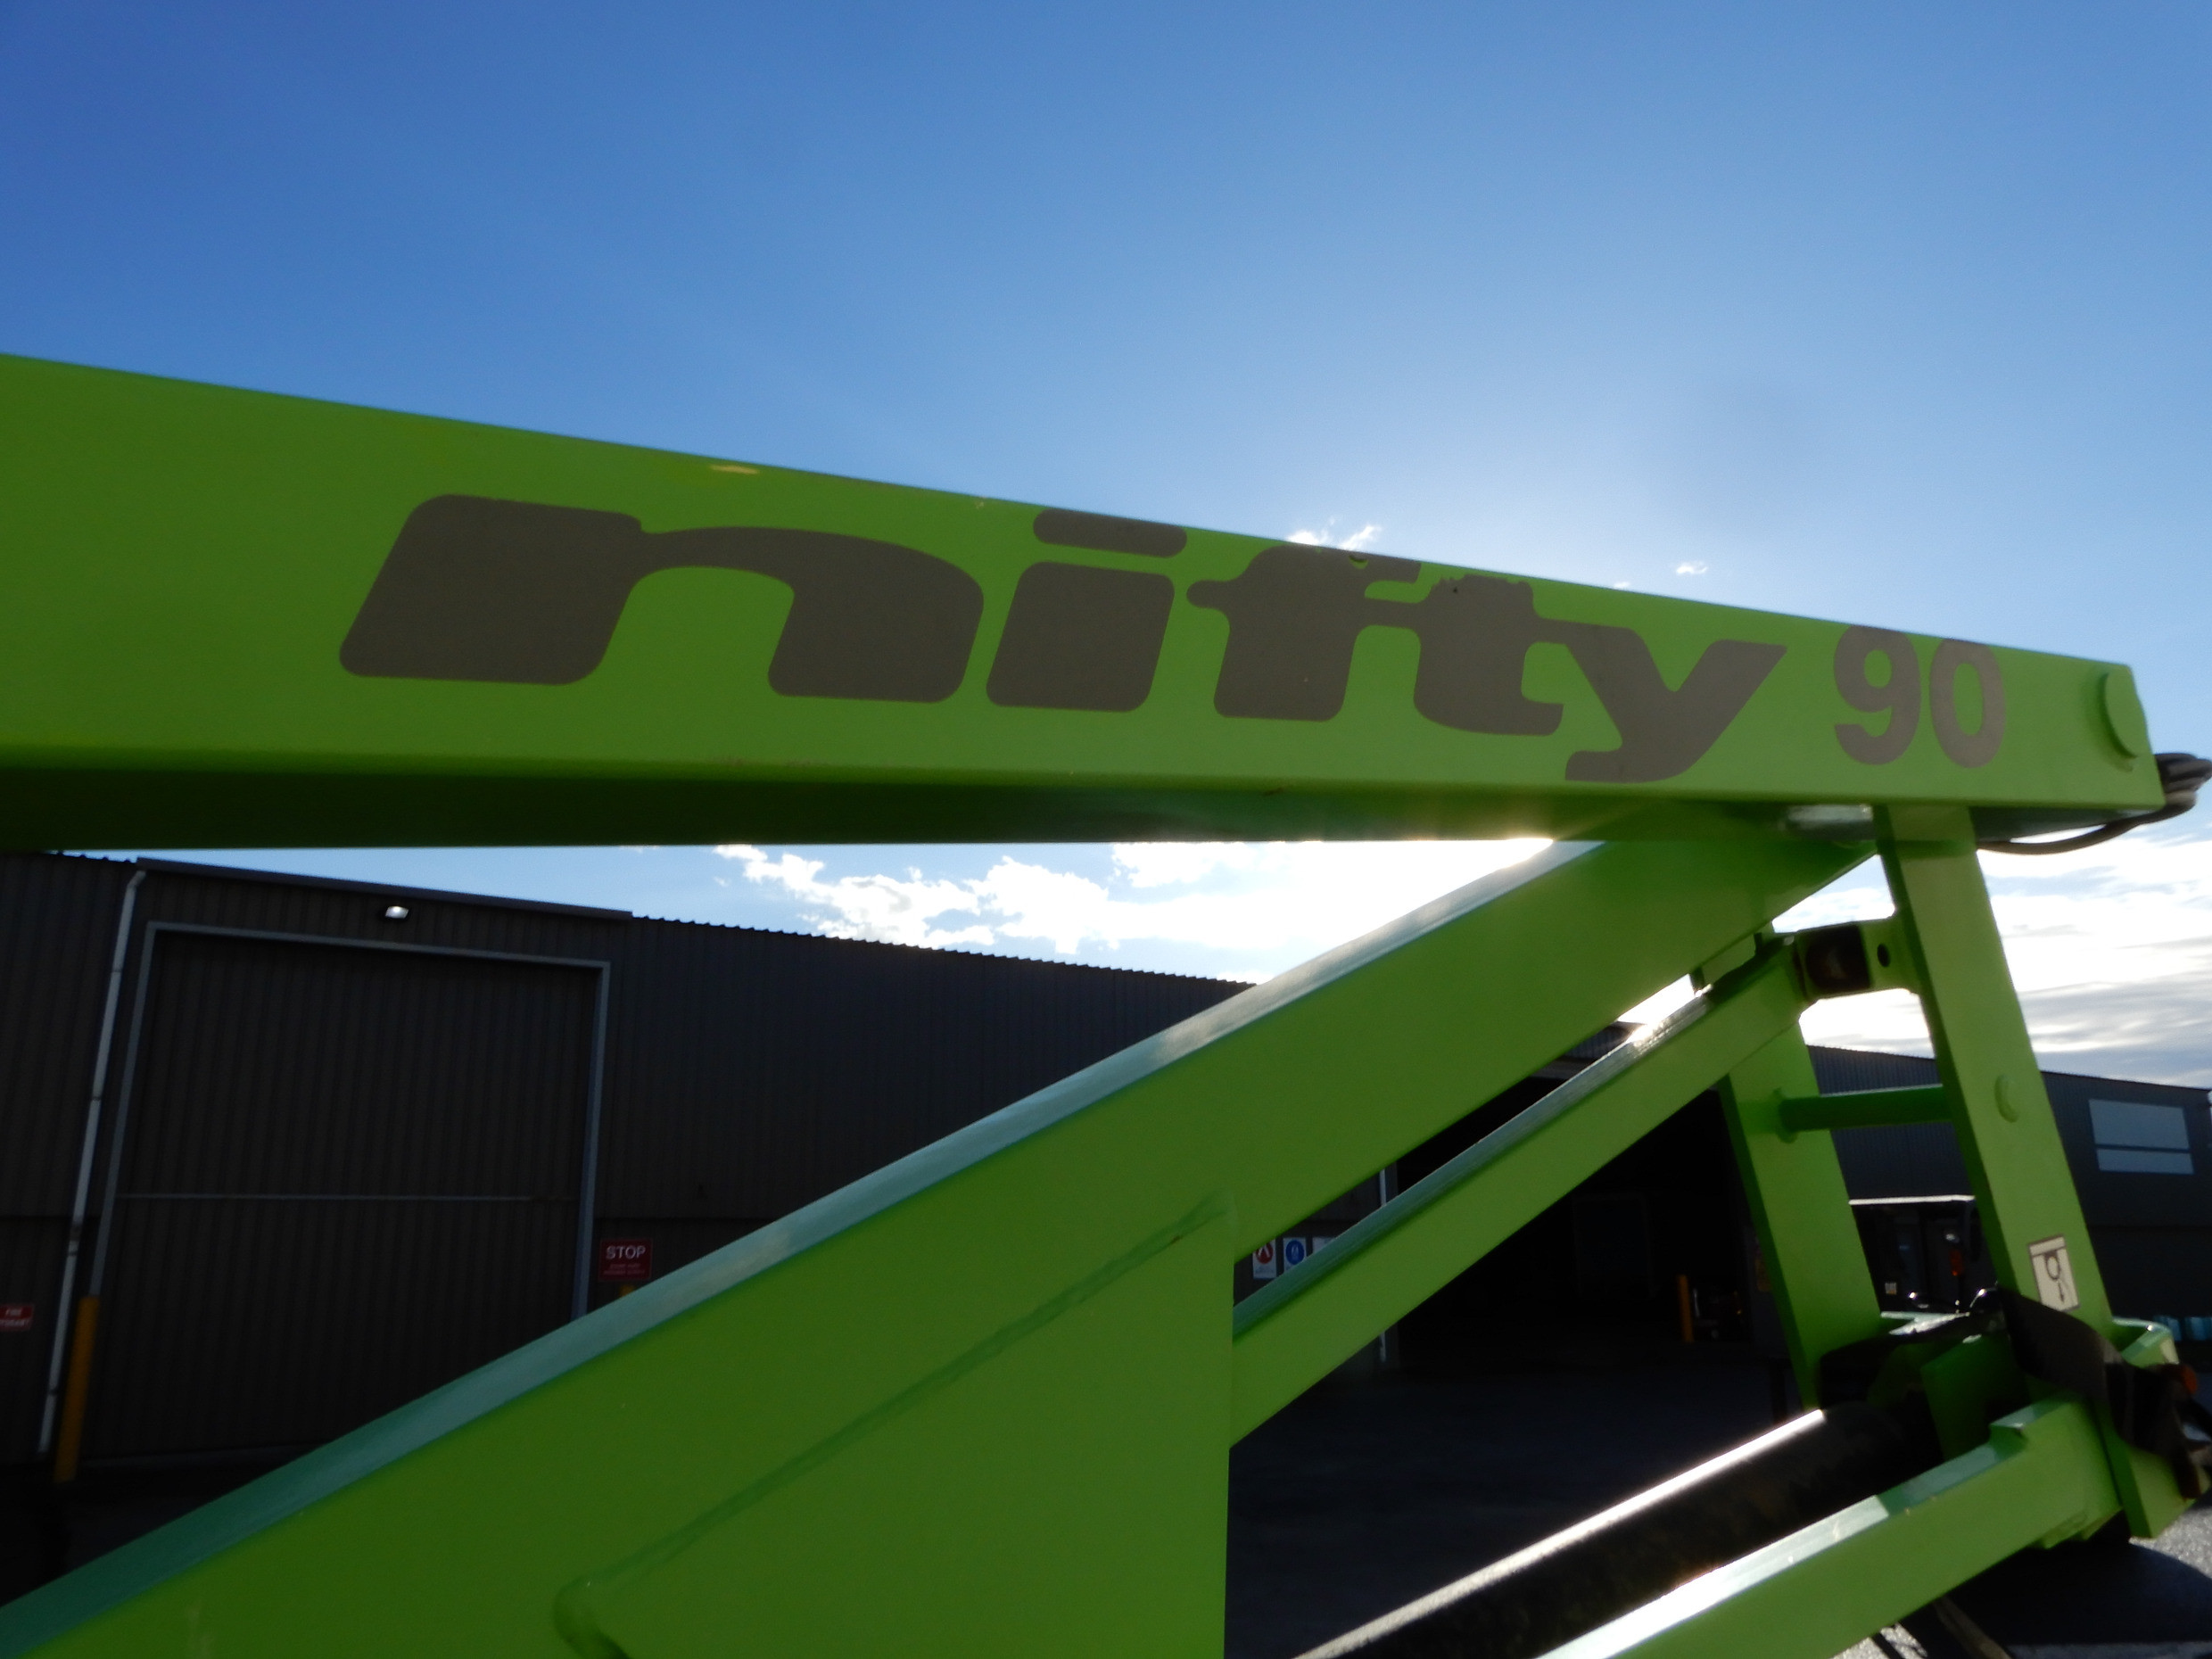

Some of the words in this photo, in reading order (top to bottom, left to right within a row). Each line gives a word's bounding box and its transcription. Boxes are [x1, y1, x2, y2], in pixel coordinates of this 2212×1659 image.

[340, 494, 1787, 783] nifty
[1833, 623, 2006, 769] 90
[607, 1245, 646, 1259] STOP
